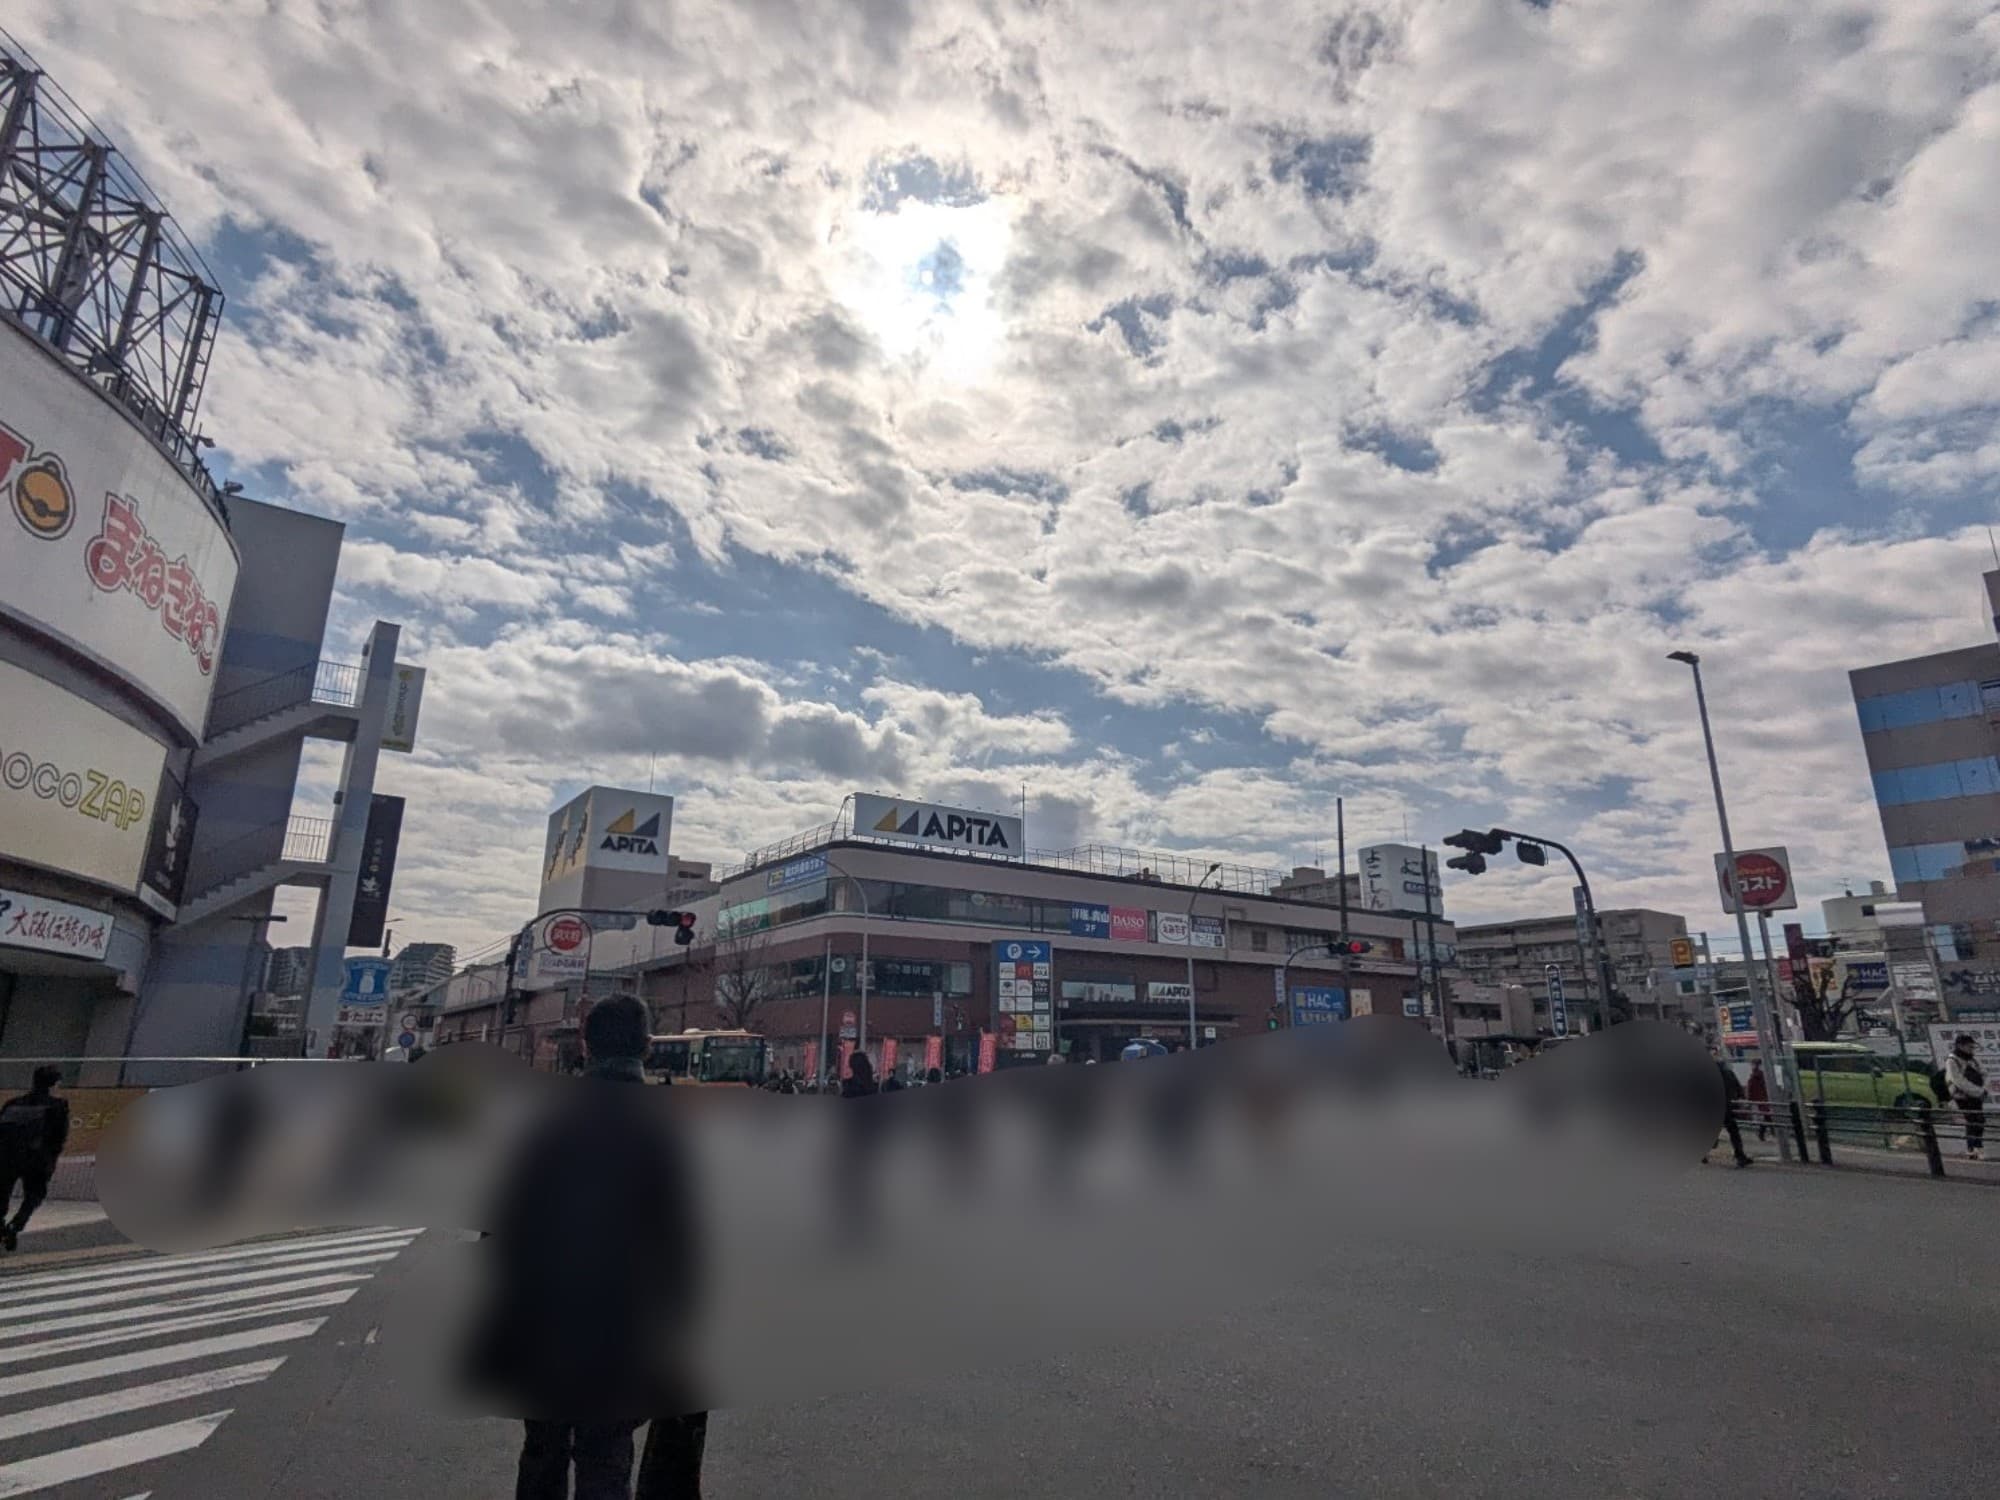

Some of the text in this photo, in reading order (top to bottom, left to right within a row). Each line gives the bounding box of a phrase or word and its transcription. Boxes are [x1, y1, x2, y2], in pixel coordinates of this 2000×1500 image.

[84, 491, 219, 676] まねきねこ
[0, 750, 146, 831] ocoZAP
[1365, 848, 1385, 909] よこしん
[5, 905, 105, 951] 大阪伝統の味
[1113, 916, 1145, 928] DAISO
[1307, 992, 1331, 1009] HAC
